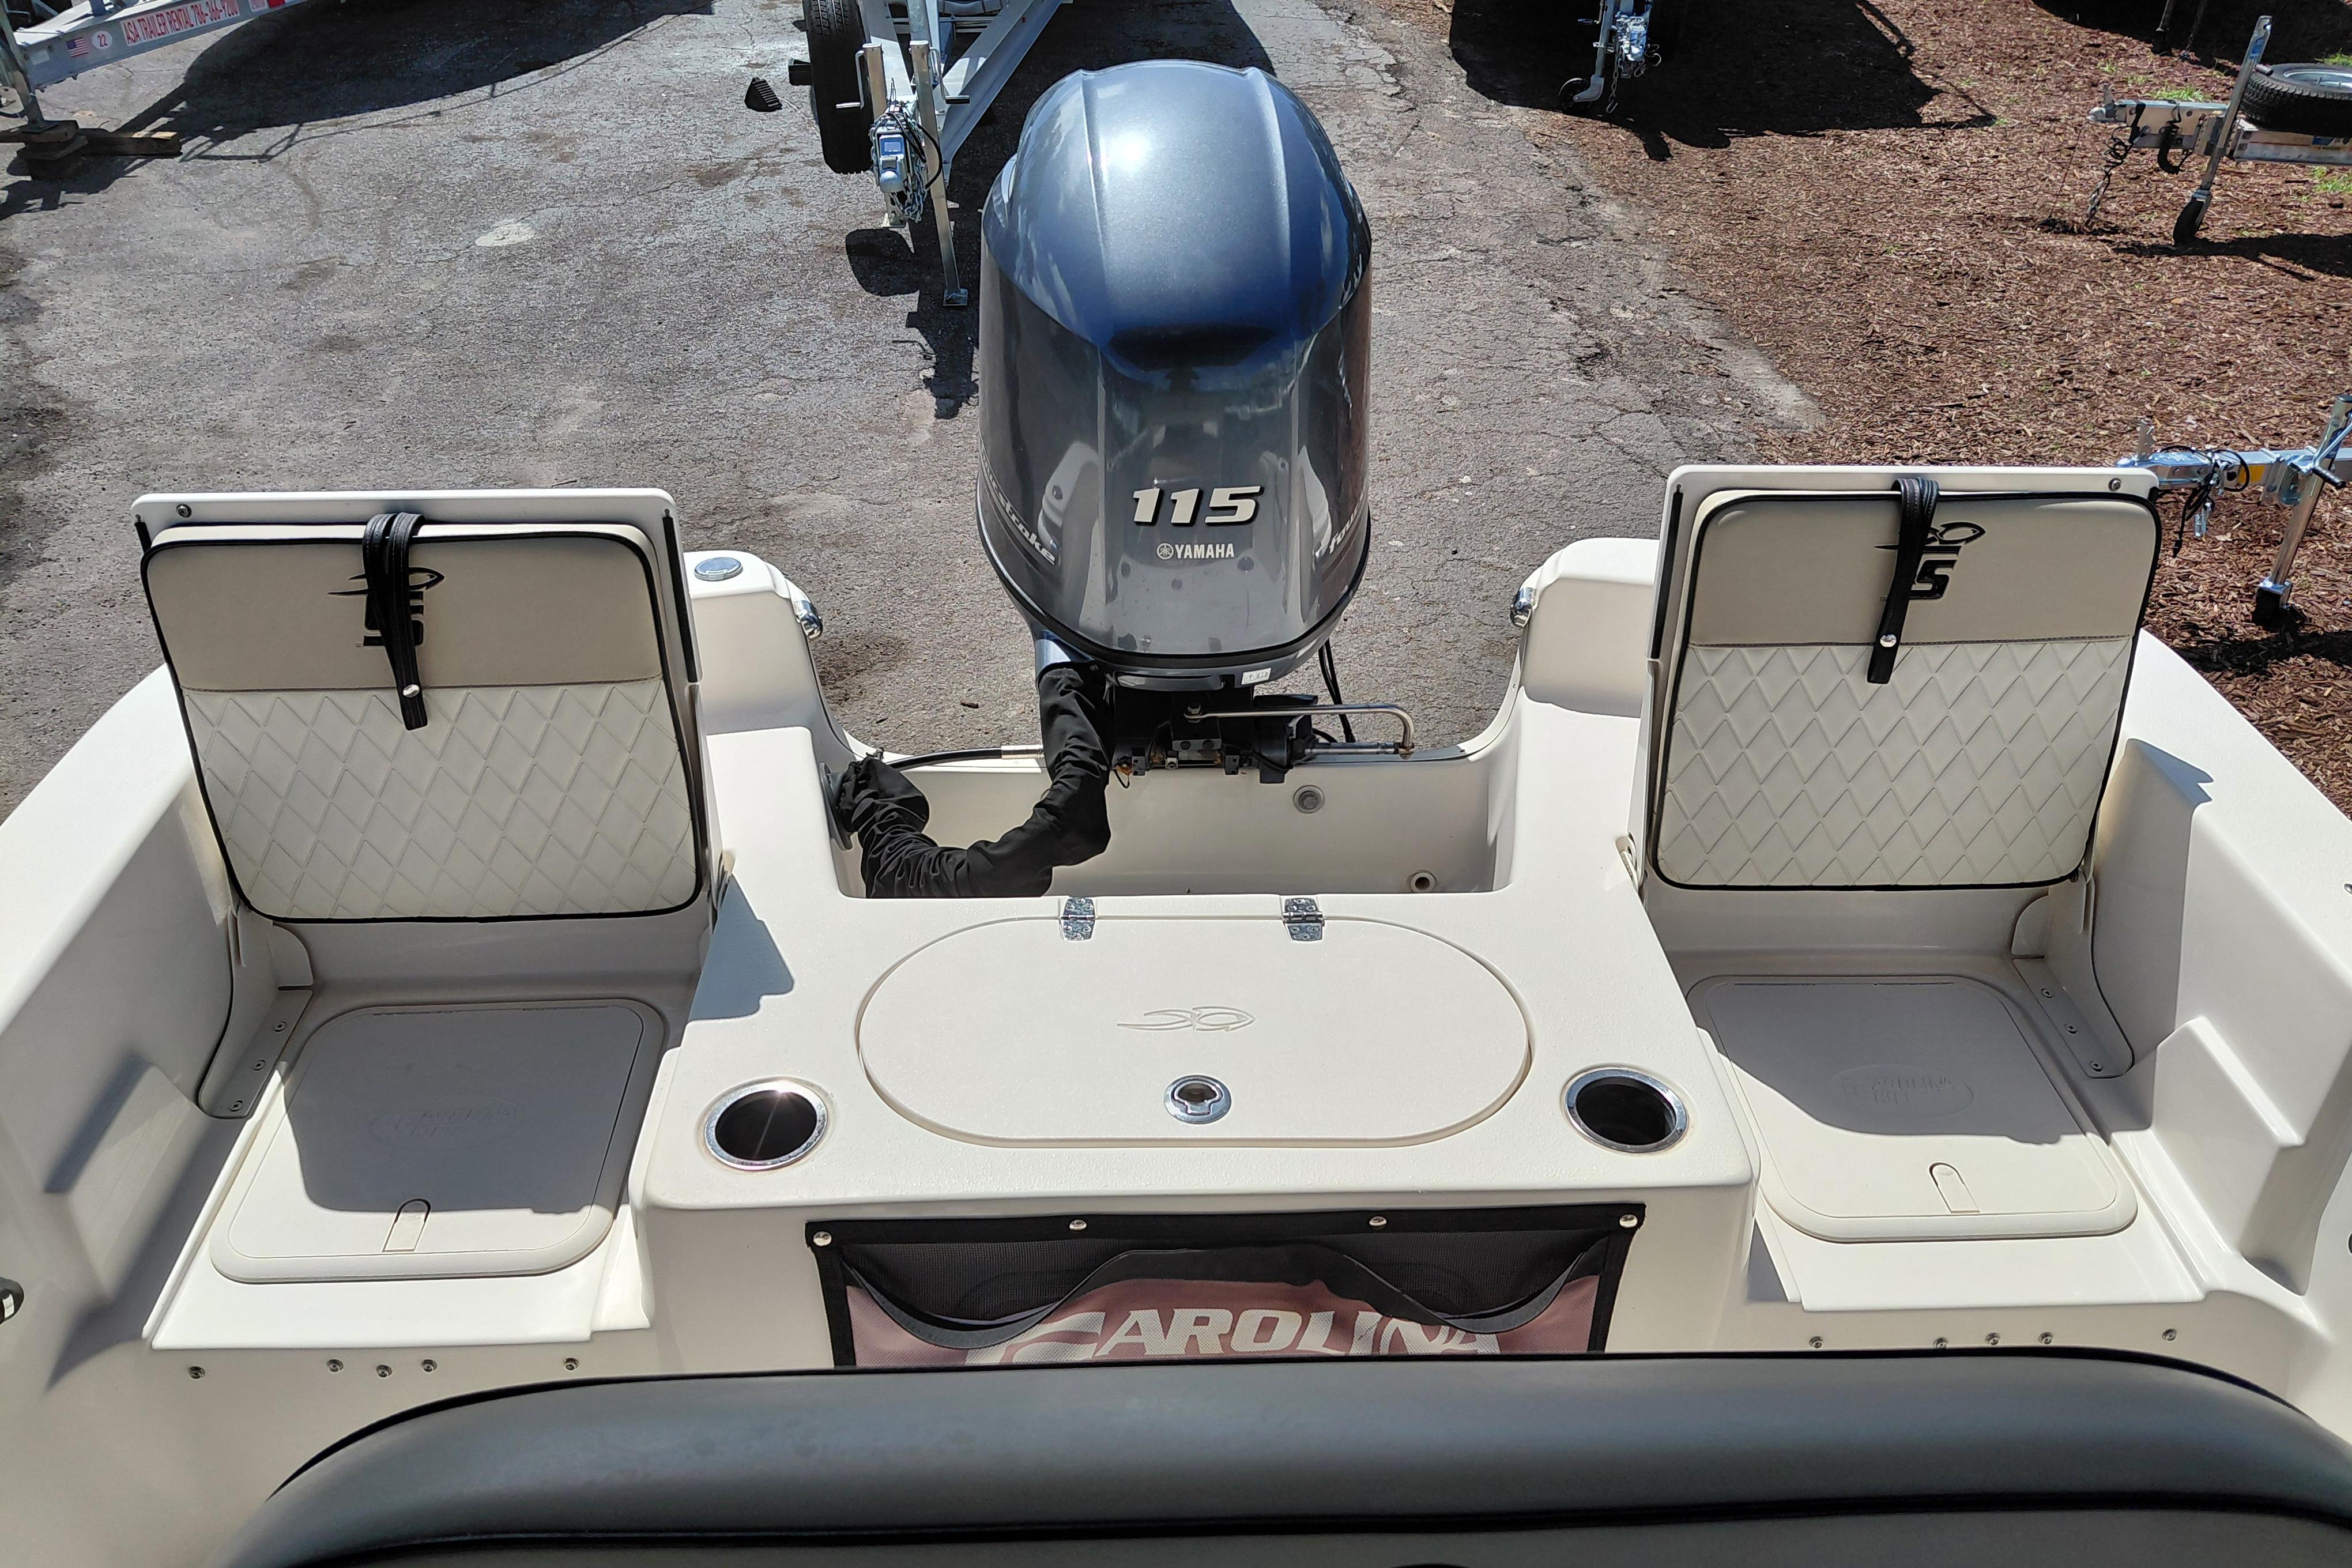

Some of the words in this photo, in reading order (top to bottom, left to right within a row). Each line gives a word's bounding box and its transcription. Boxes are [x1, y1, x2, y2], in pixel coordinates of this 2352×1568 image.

[97, 33, 108, 47] 22
[123, 21, 140, 44] ASA
[137, 13, 167, 40] TRAILER
[166, 6, 194, 33] RENTAL
[1133, 485, 1263, 525] 115
[998, 492, 1056, 566] stroke
[1175, 543, 1235, 559] YAMAHA
